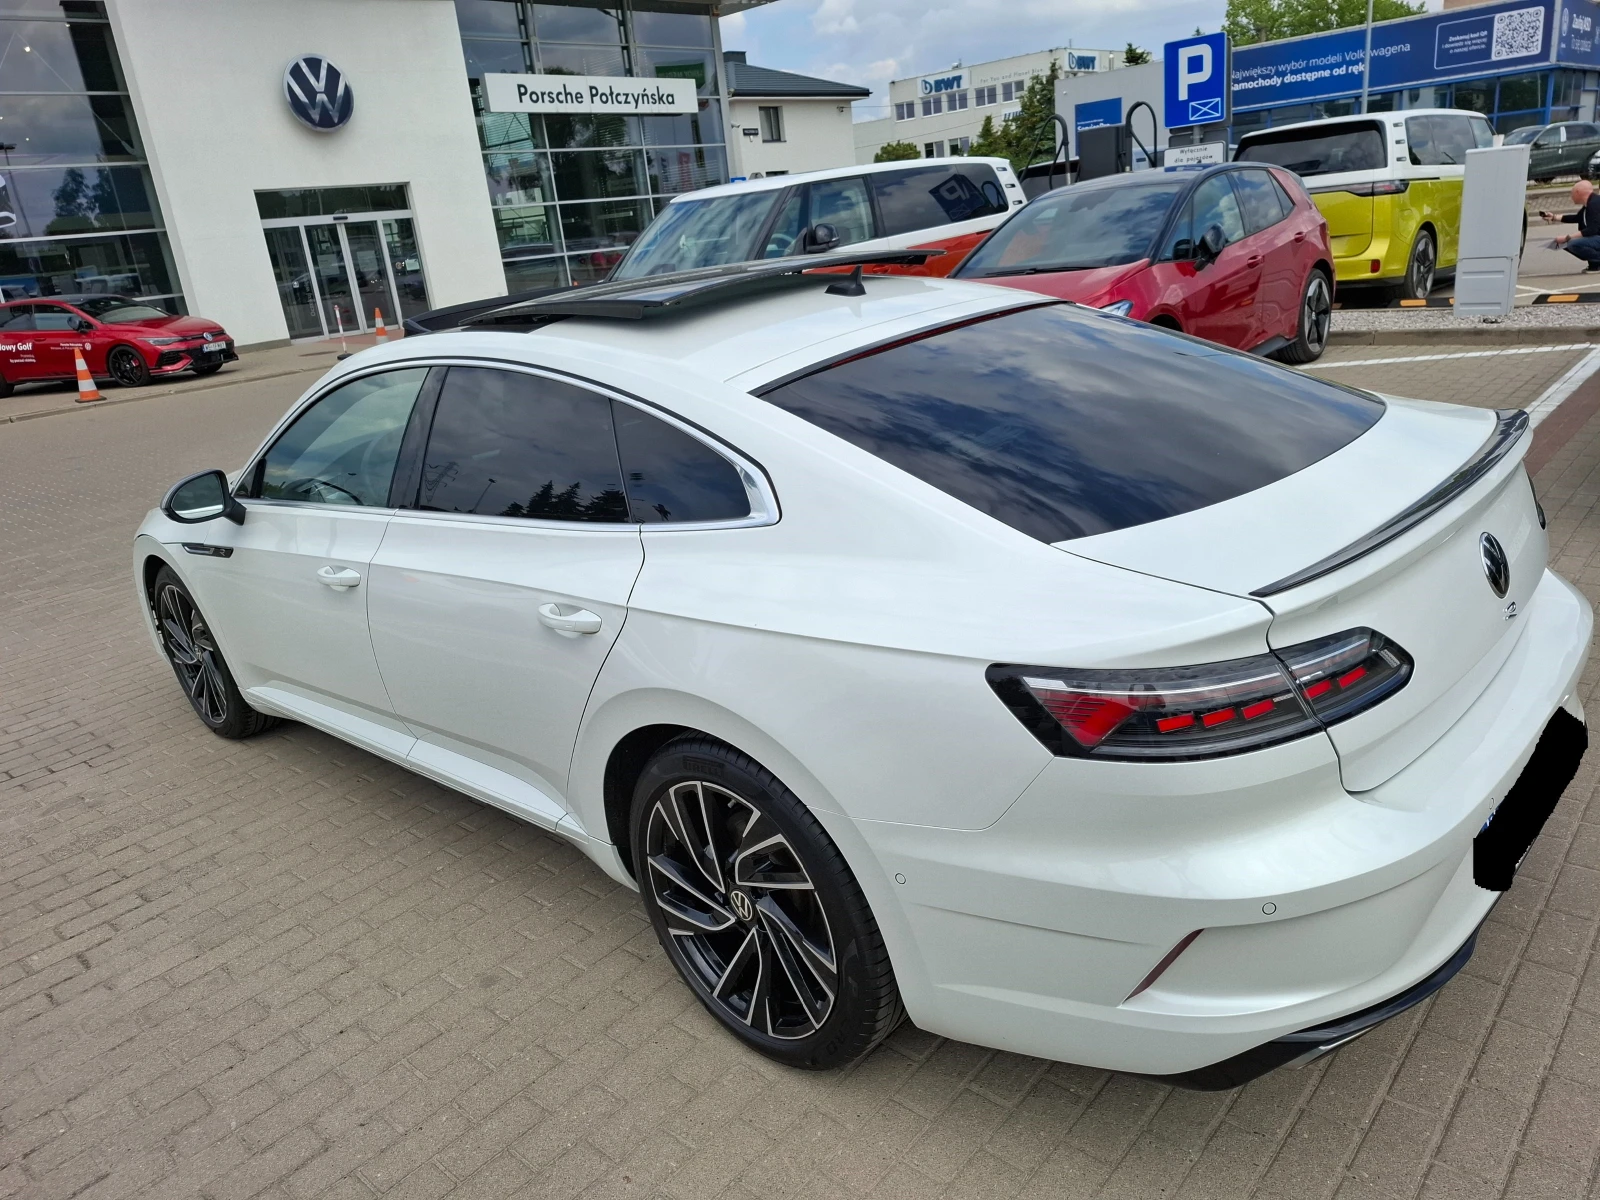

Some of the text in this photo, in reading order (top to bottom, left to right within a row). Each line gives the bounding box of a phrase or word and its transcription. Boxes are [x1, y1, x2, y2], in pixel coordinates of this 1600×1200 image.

[1278, 59, 1308, 73] wybór
[1309, 53, 1342, 66] modeli
[1345, 43, 1411, 61] Volkwagena
[1178, 43, 1213, 101] P
[1284, 69, 1331, 83] dostępne
[1332, 64, 1346, 76] od
[934, 74, 963, 93] BWT
[516, 83, 675, 109] Porsche Połczyńska
[17, 342, 32, 351] Golf
